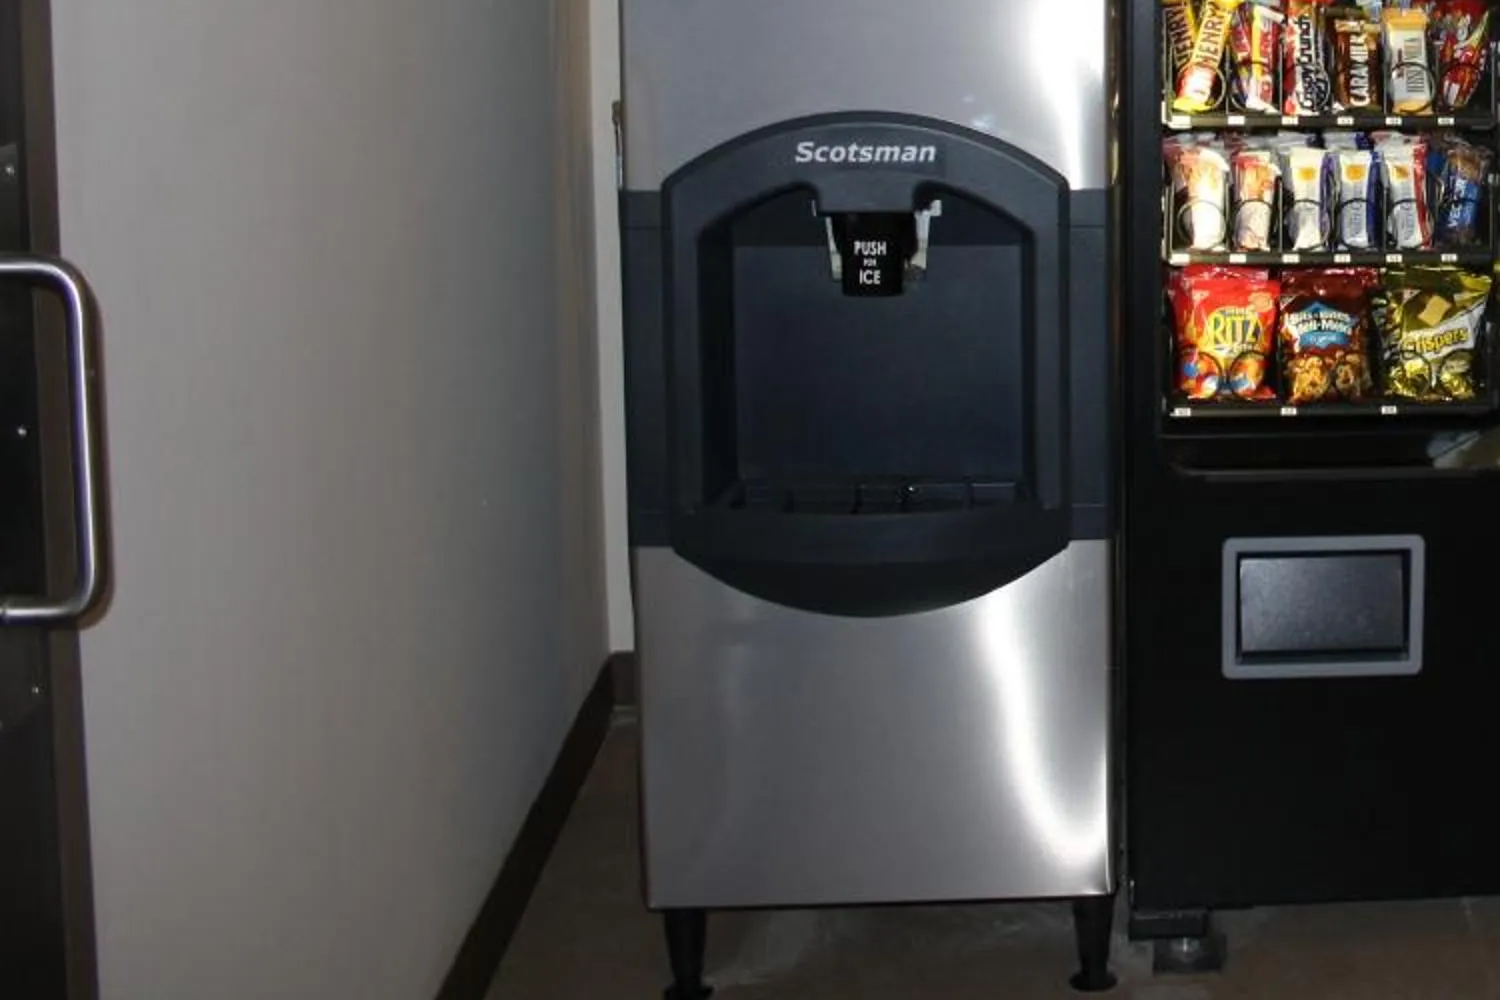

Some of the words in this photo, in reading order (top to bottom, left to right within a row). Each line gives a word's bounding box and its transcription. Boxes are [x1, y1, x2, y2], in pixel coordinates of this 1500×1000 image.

[794, 141, 937, 163] Scotsman
[853, 240, 887, 256] PUSH
[858, 269, 881, 285] ICE
[1210, 311, 1260, 344] RITZ
